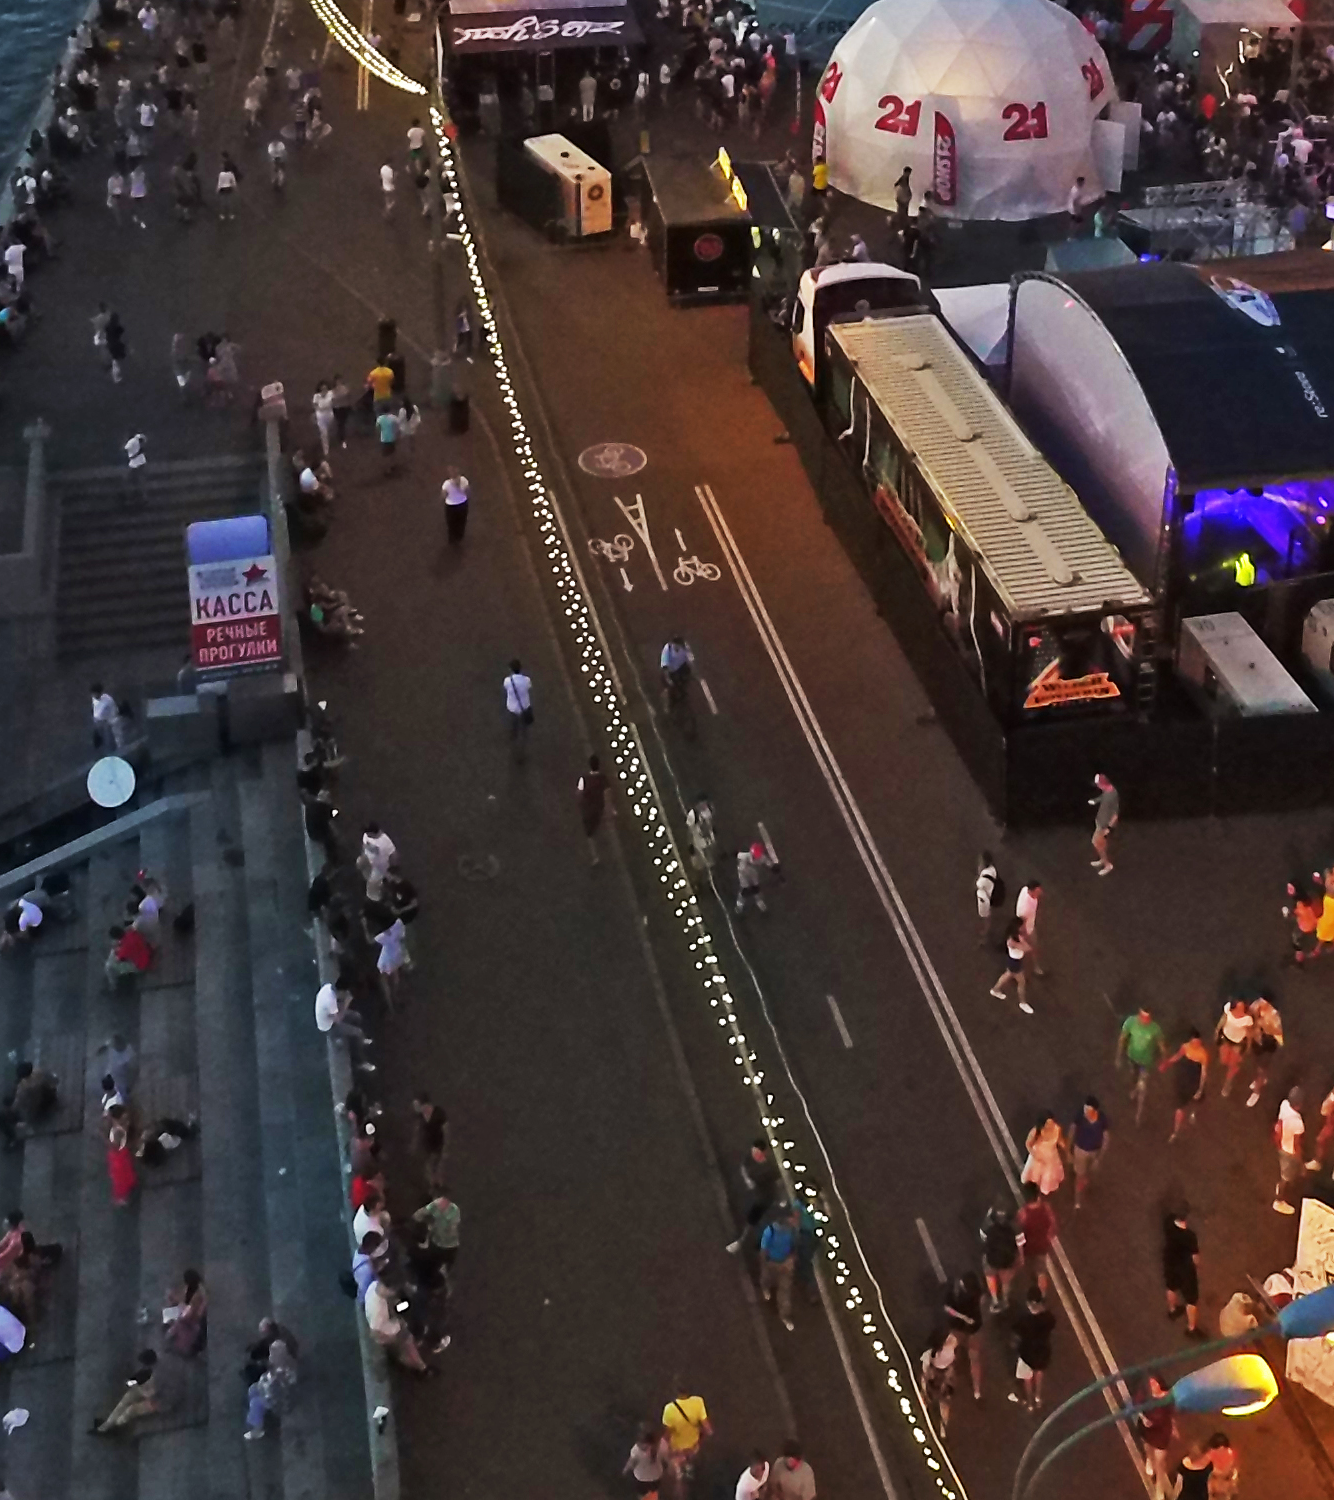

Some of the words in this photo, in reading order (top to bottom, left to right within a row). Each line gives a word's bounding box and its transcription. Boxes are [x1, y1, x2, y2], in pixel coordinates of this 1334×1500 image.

[875, 95, 922, 136] 21
[1002, 102, 1048, 141] 21
[195, 589, 273, 620] КАССА
[206, 621, 268, 643] РЕЧНЫЕ
[199, 638, 278, 663] ПРОГУЛКИ
